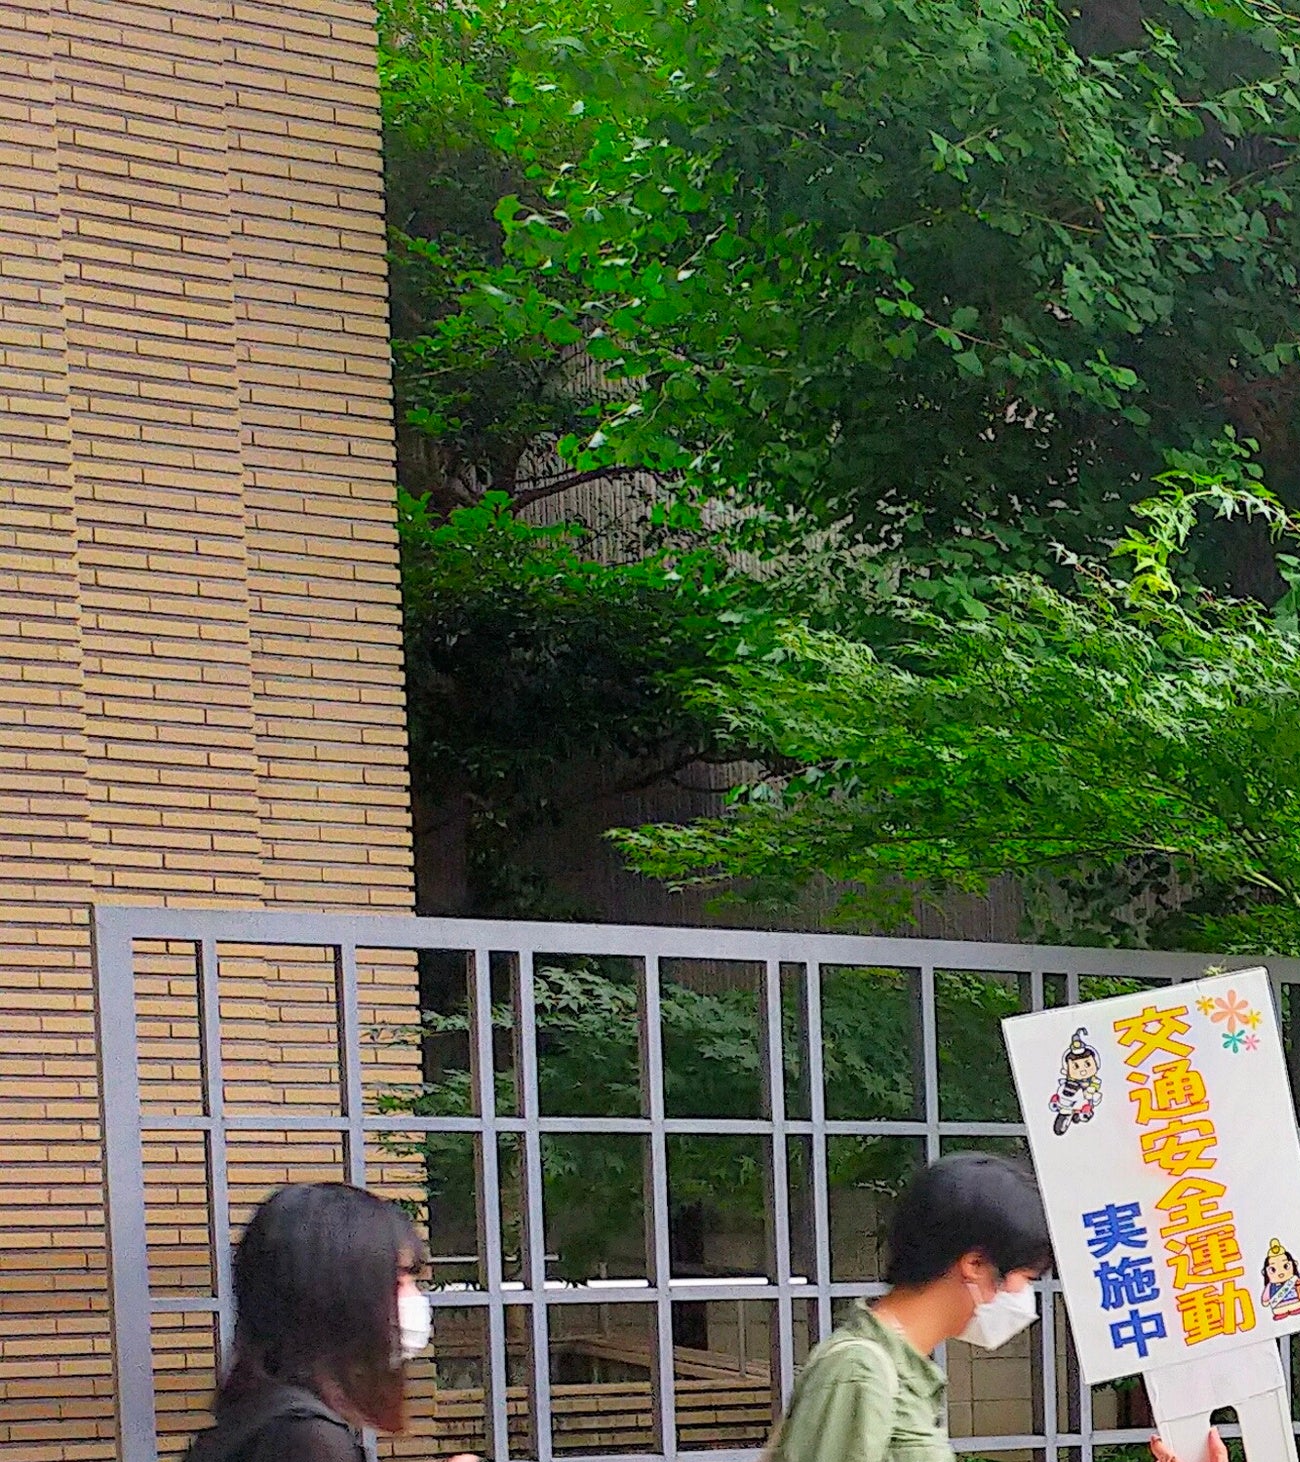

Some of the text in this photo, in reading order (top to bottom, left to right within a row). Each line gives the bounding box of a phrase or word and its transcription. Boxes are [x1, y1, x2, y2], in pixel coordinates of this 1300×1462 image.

[1082, 1200, 1168, 1359] 実施中
[1112, 1004, 1257, 1347] 交通安全運動
